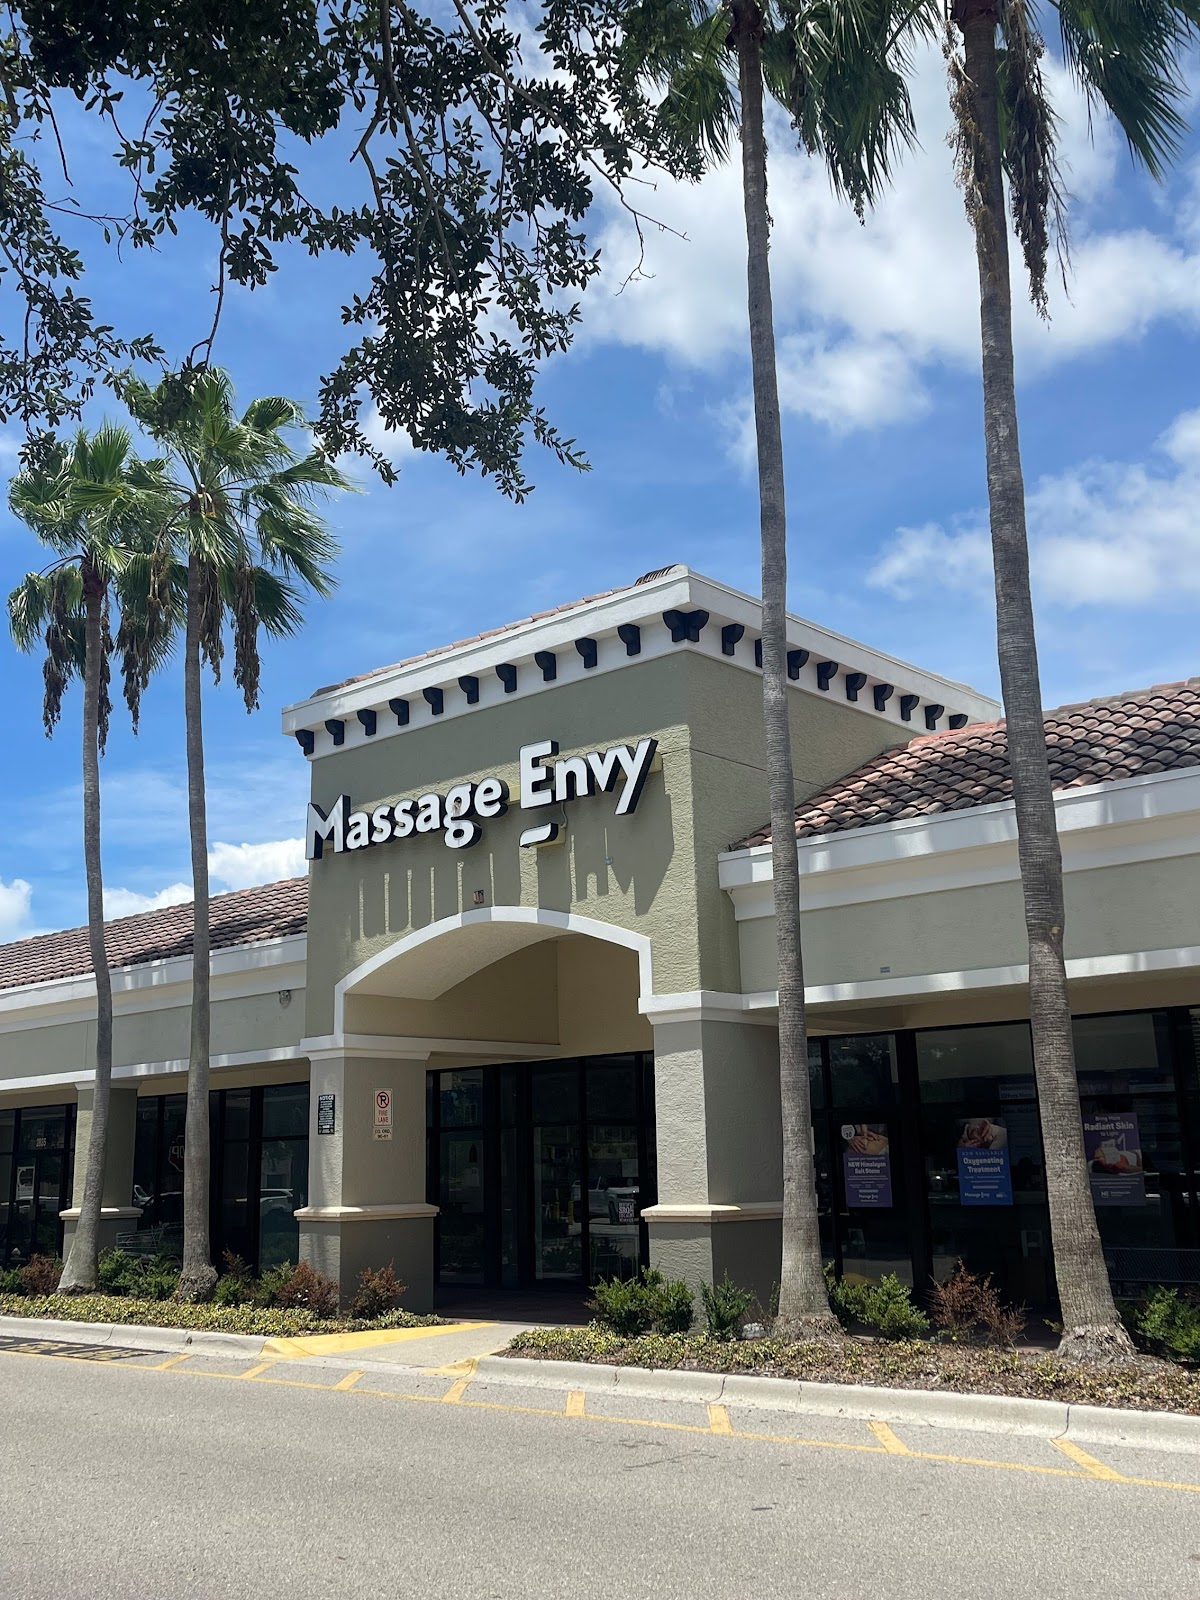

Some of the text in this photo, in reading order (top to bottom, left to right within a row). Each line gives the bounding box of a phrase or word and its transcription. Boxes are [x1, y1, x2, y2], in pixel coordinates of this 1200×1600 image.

[305, 738, 658, 859] Massage Envy
[1084, 1121, 1134, 1131] Radiant Skin
[963, 1157, 1004, 1166] Oxygenating
